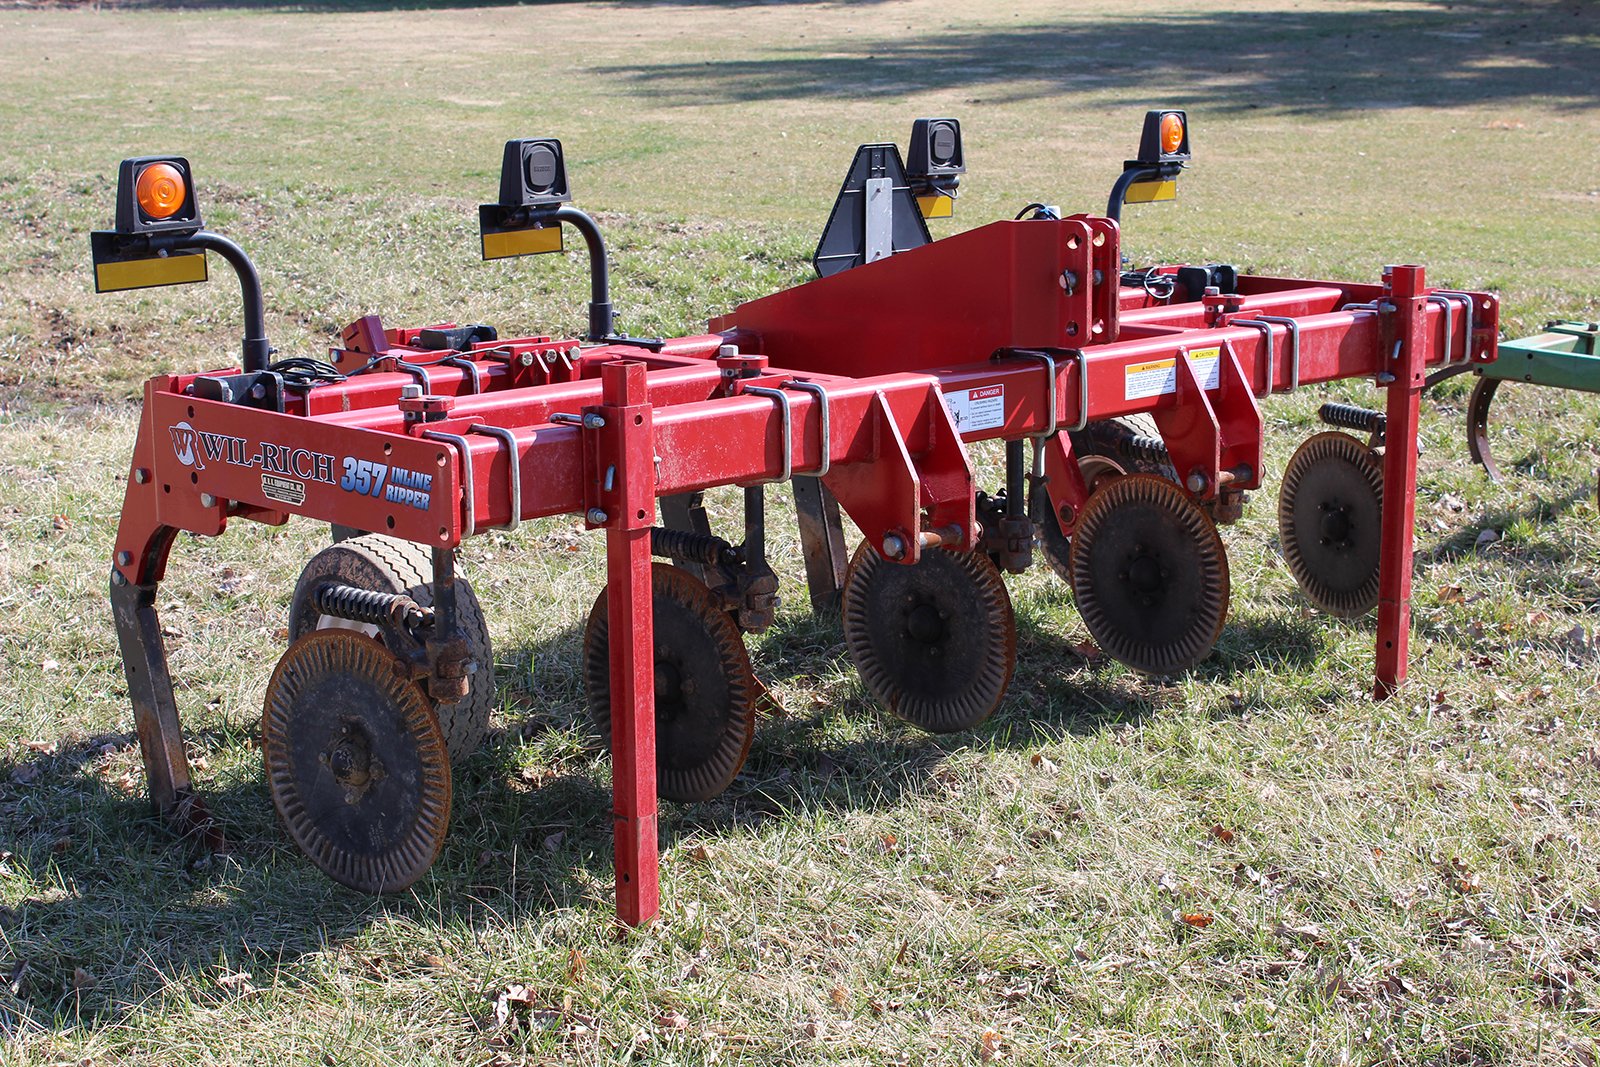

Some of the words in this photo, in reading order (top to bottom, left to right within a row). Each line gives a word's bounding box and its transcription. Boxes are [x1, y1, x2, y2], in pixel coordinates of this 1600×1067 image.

[979, 388, 1000, 397] DANGER
[198, 431, 337, 485] WIL-RICH
[340, 456, 388, 498] 357
[390, 466, 433, 492] INLINE
[384, 484, 431, 511] RIPPER
